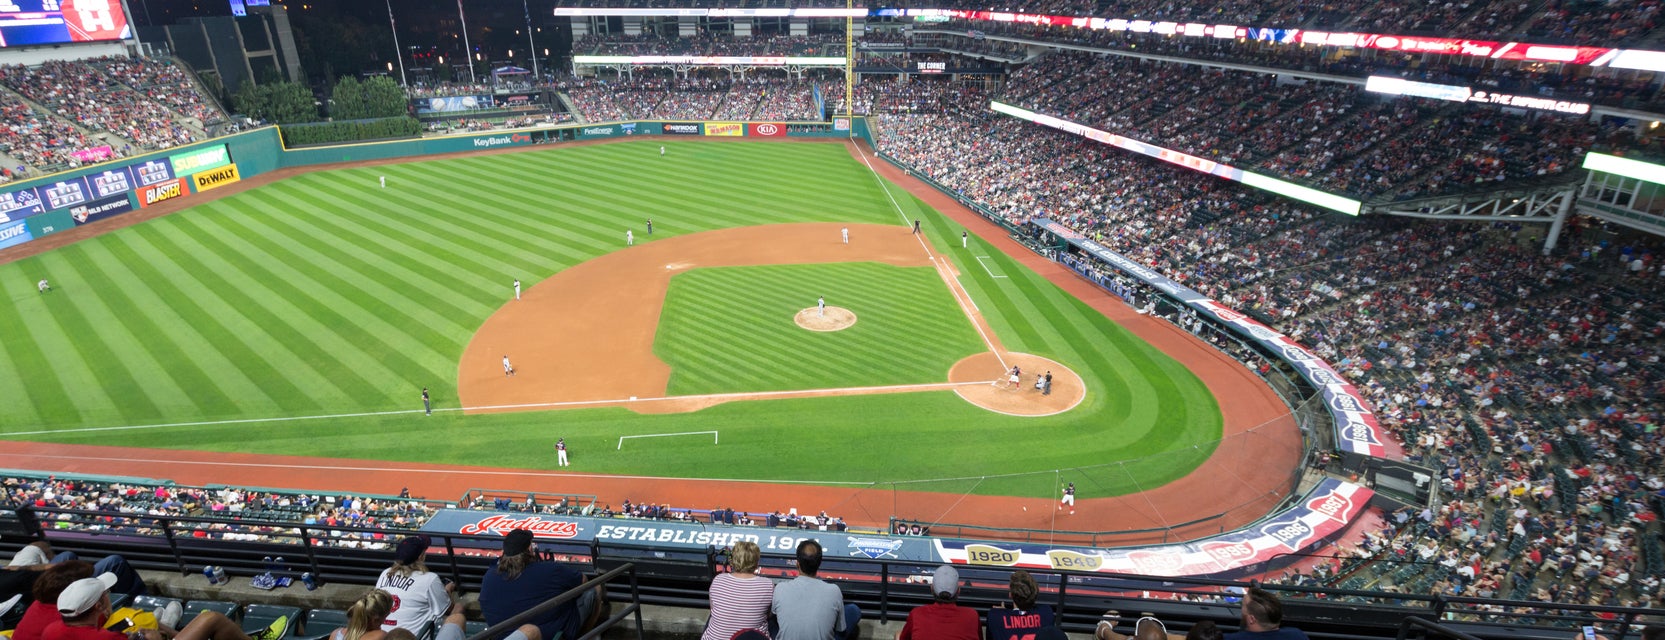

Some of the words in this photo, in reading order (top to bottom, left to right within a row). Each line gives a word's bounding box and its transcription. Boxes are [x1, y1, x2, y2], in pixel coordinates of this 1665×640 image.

[474, 136, 511, 147] KeyBank
[174, 148, 225, 173] SUBWAY
[146, 182, 182, 205] BLASTER
[101, 199, 130, 212] NETWORK
[1317, 495, 1347, 516] 1997
[460, 514, 577, 539] Indians
[1272, 521, 1309, 543] 1996
[971, 551, 1013, 563] 1920
[1003, 614, 1041, 629] LINDOR
